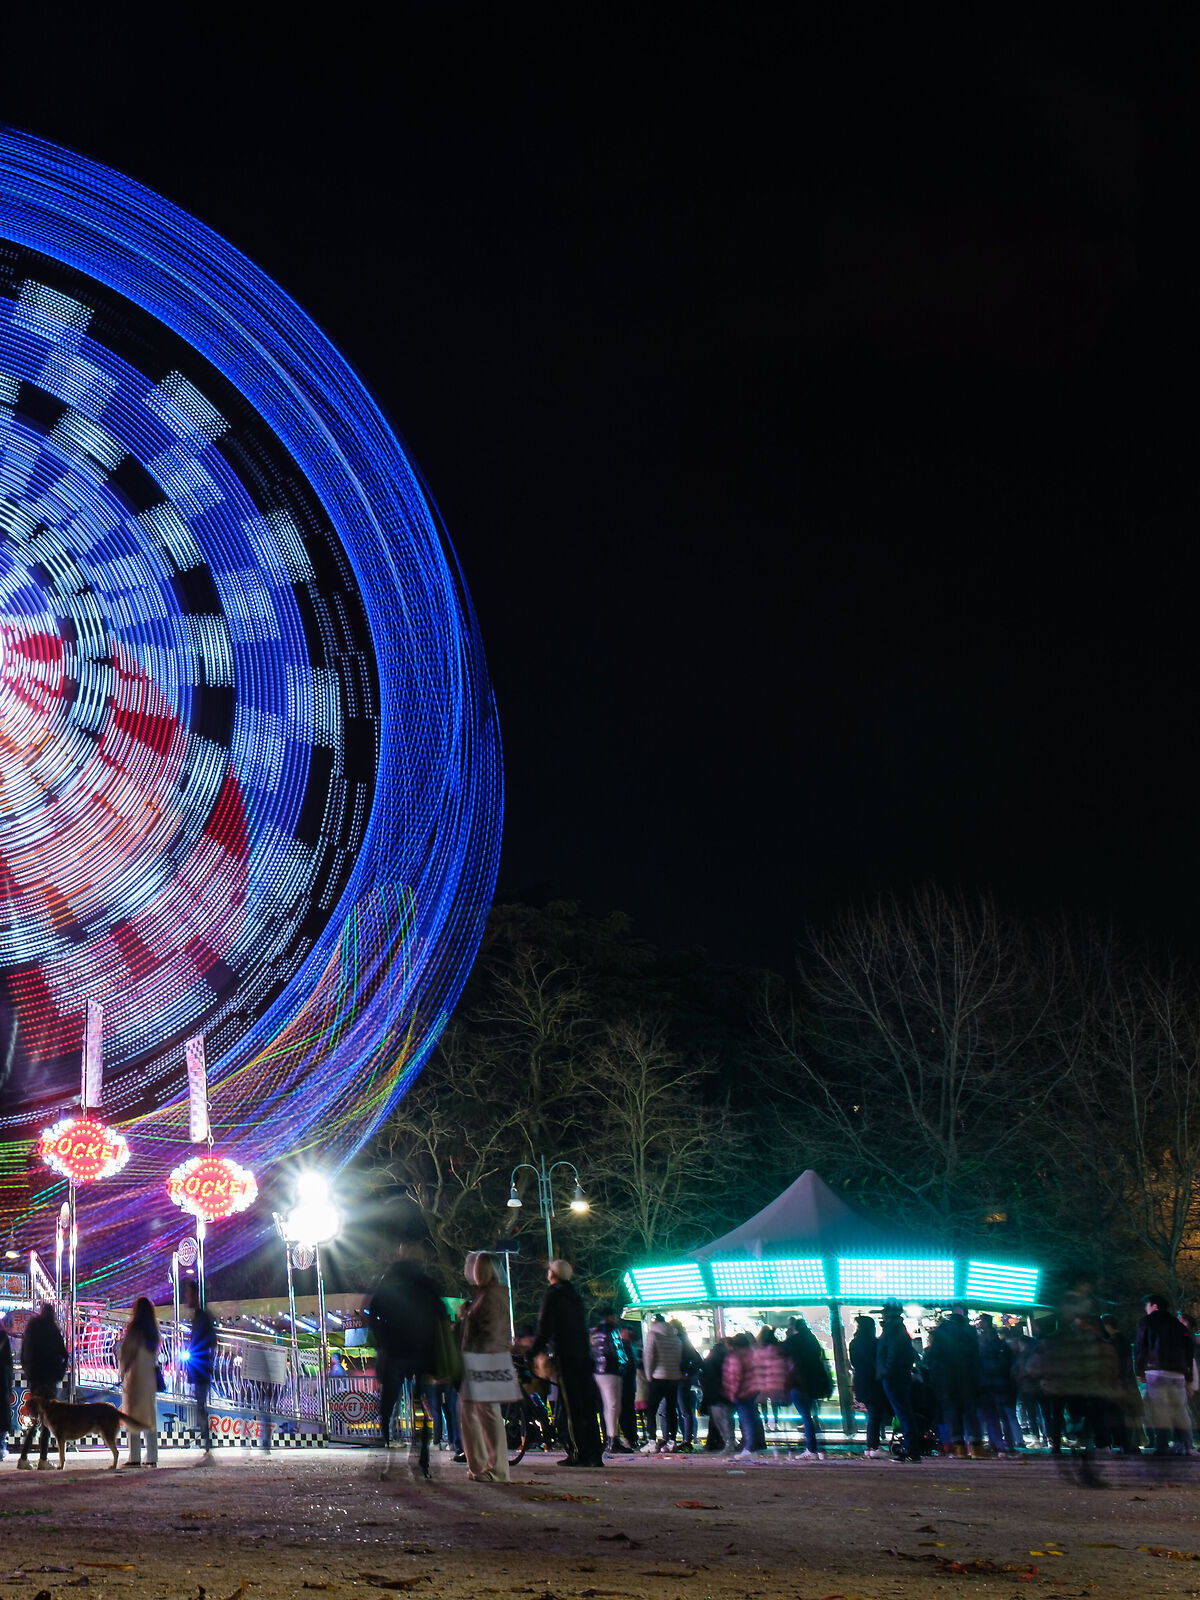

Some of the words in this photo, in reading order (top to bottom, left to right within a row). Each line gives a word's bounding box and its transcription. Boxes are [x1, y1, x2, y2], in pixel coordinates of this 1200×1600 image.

[41, 1137, 128, 1160] ROCKET
[13, 1313, 33, 1322] 30
[329, 1402, 358, 1412] ROCKET
[360, 1402, 379, 1412] PARK
[208, 1415, 276, 1438] ROCKET
